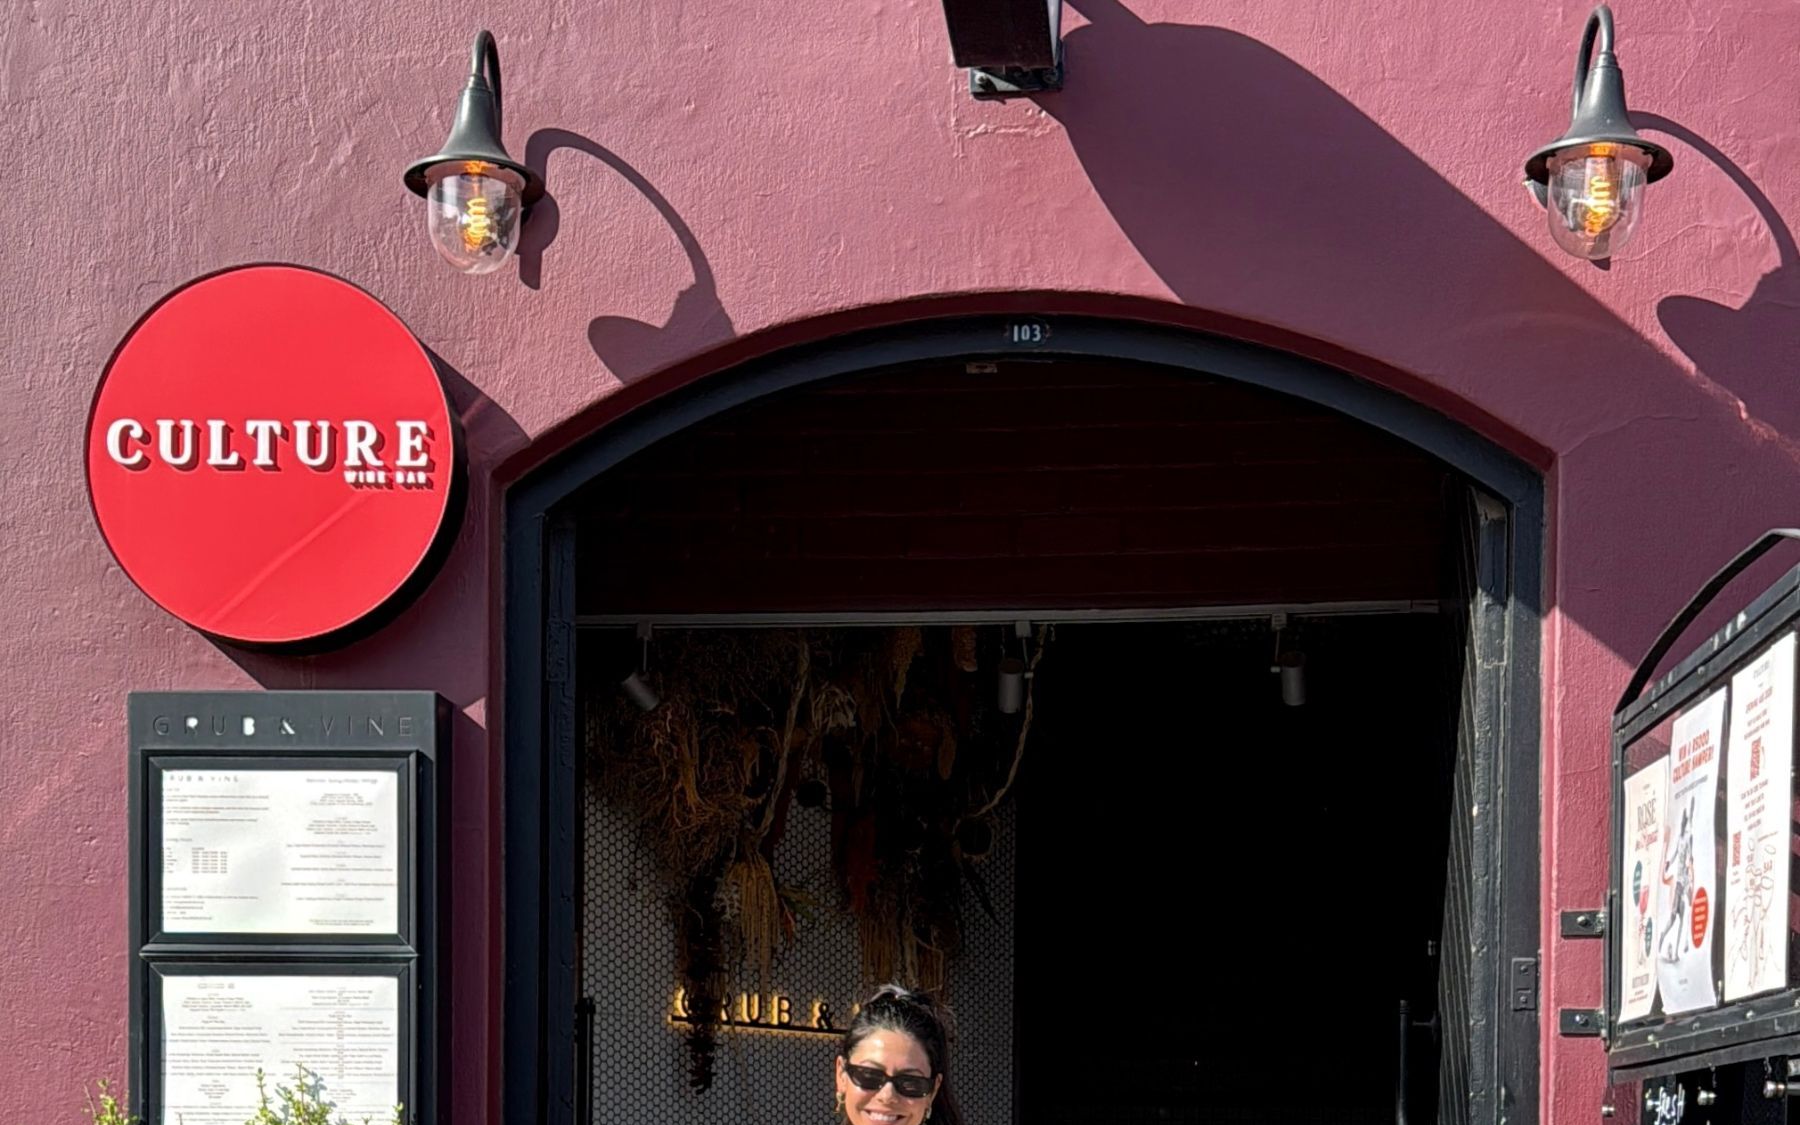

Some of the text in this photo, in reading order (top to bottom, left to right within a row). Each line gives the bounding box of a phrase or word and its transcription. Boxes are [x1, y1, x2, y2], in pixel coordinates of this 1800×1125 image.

[1012, 324, 1042, 342] 103
[106, 417, 434, 472] CULTURE
[152, 714, 414, 737] GRUB & VINE
